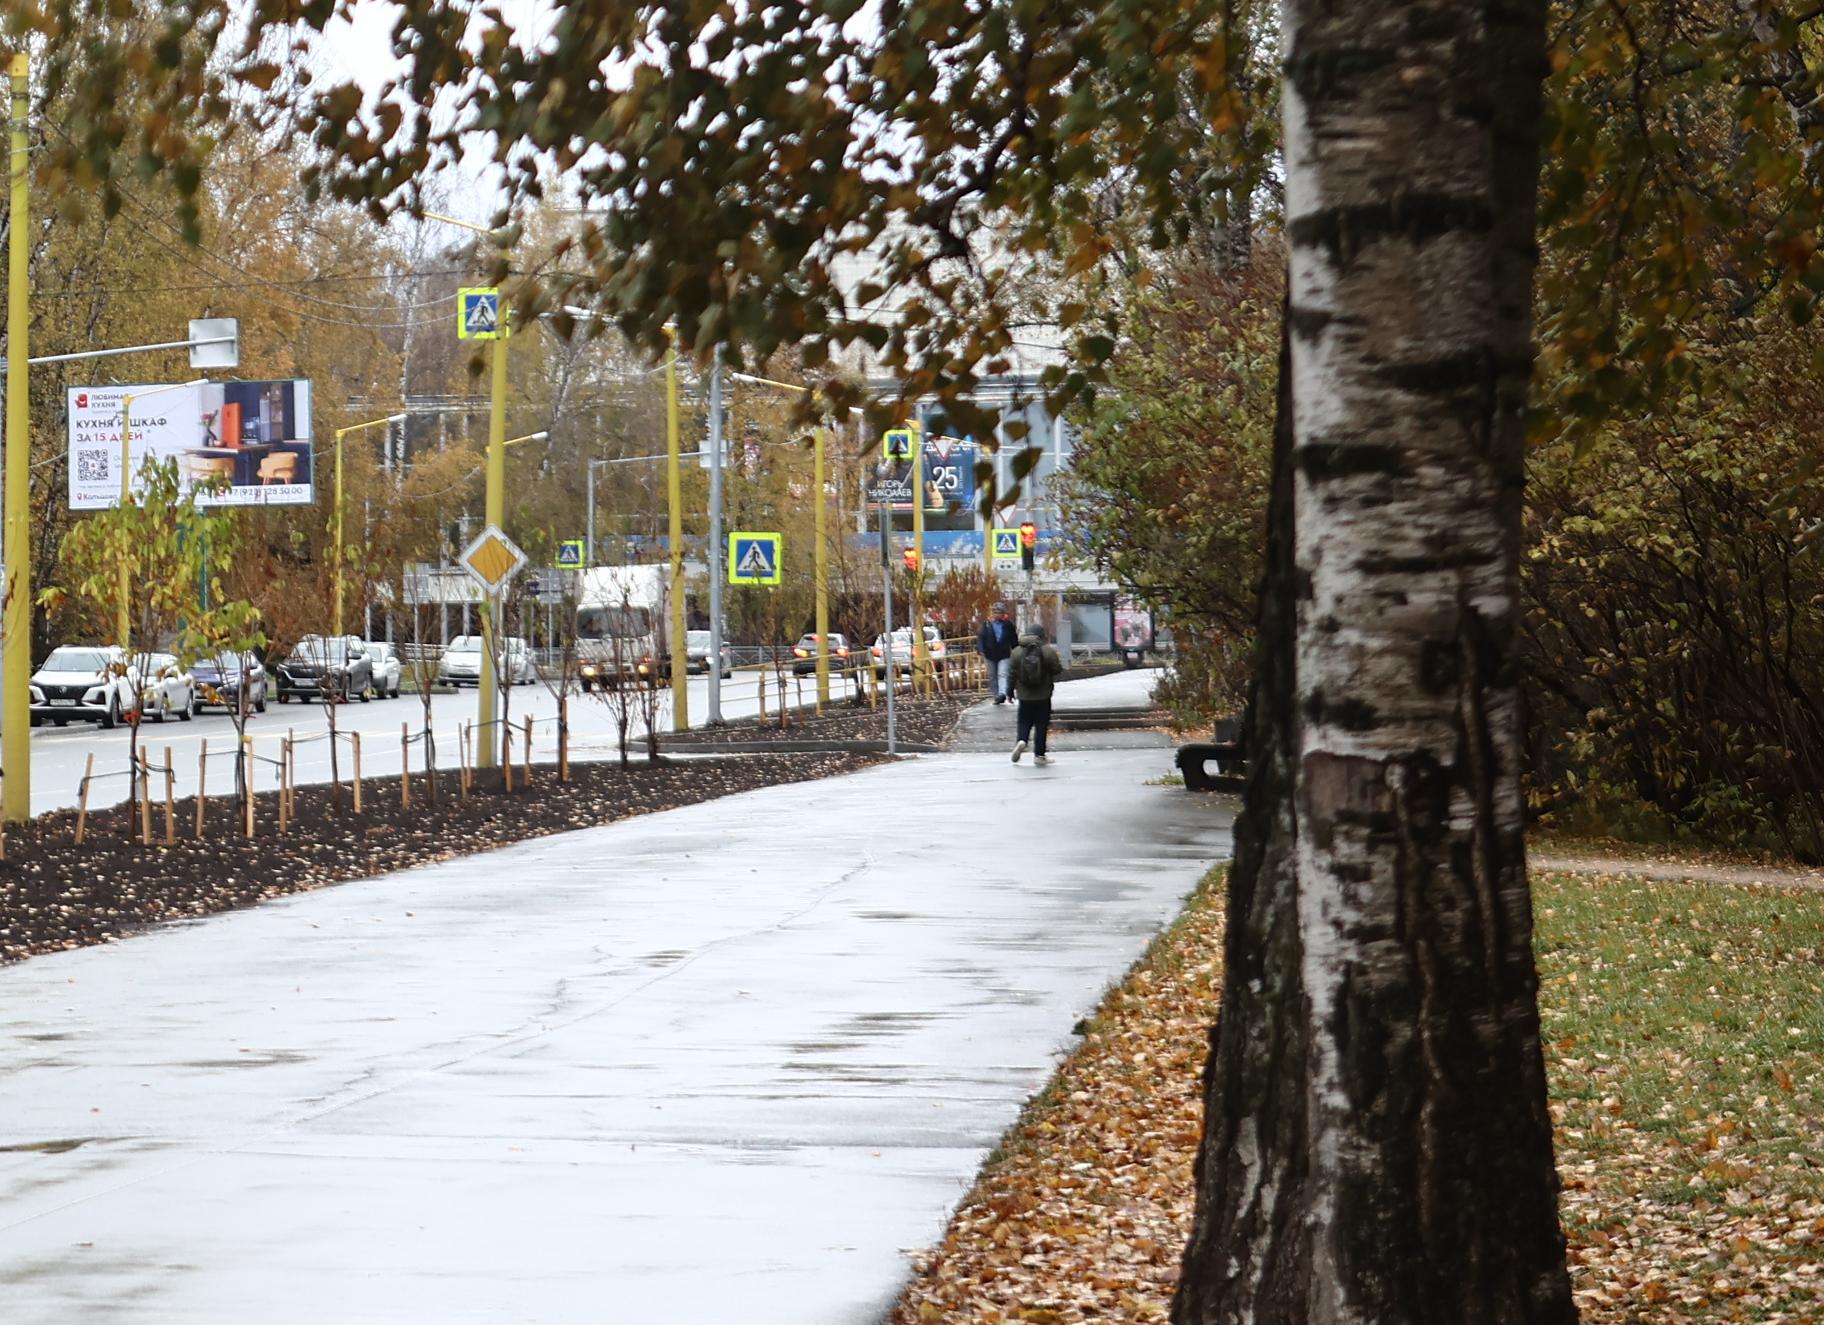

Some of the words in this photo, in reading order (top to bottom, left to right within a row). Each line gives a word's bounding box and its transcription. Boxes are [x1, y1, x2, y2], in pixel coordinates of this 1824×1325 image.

[91, 393, 127, 402] ЛЮБИМА
[91, 401, 116, 409] КУХНЯ
[76, 419, 114, 429] КУХНЯ
[130, 417, 167, 427] ШКАФ
[77, 433, 92, 443] ЗА
[94, 432, 106, 442] 15
[932, 466, 958, 490] 25
[876, 479, 903, 488] ИГОРЬ
[279, 487, 290, 495] 50
[291, 486, 303, 494] 00
[867, 488, 912, 497] НИКОЛАЕВ
